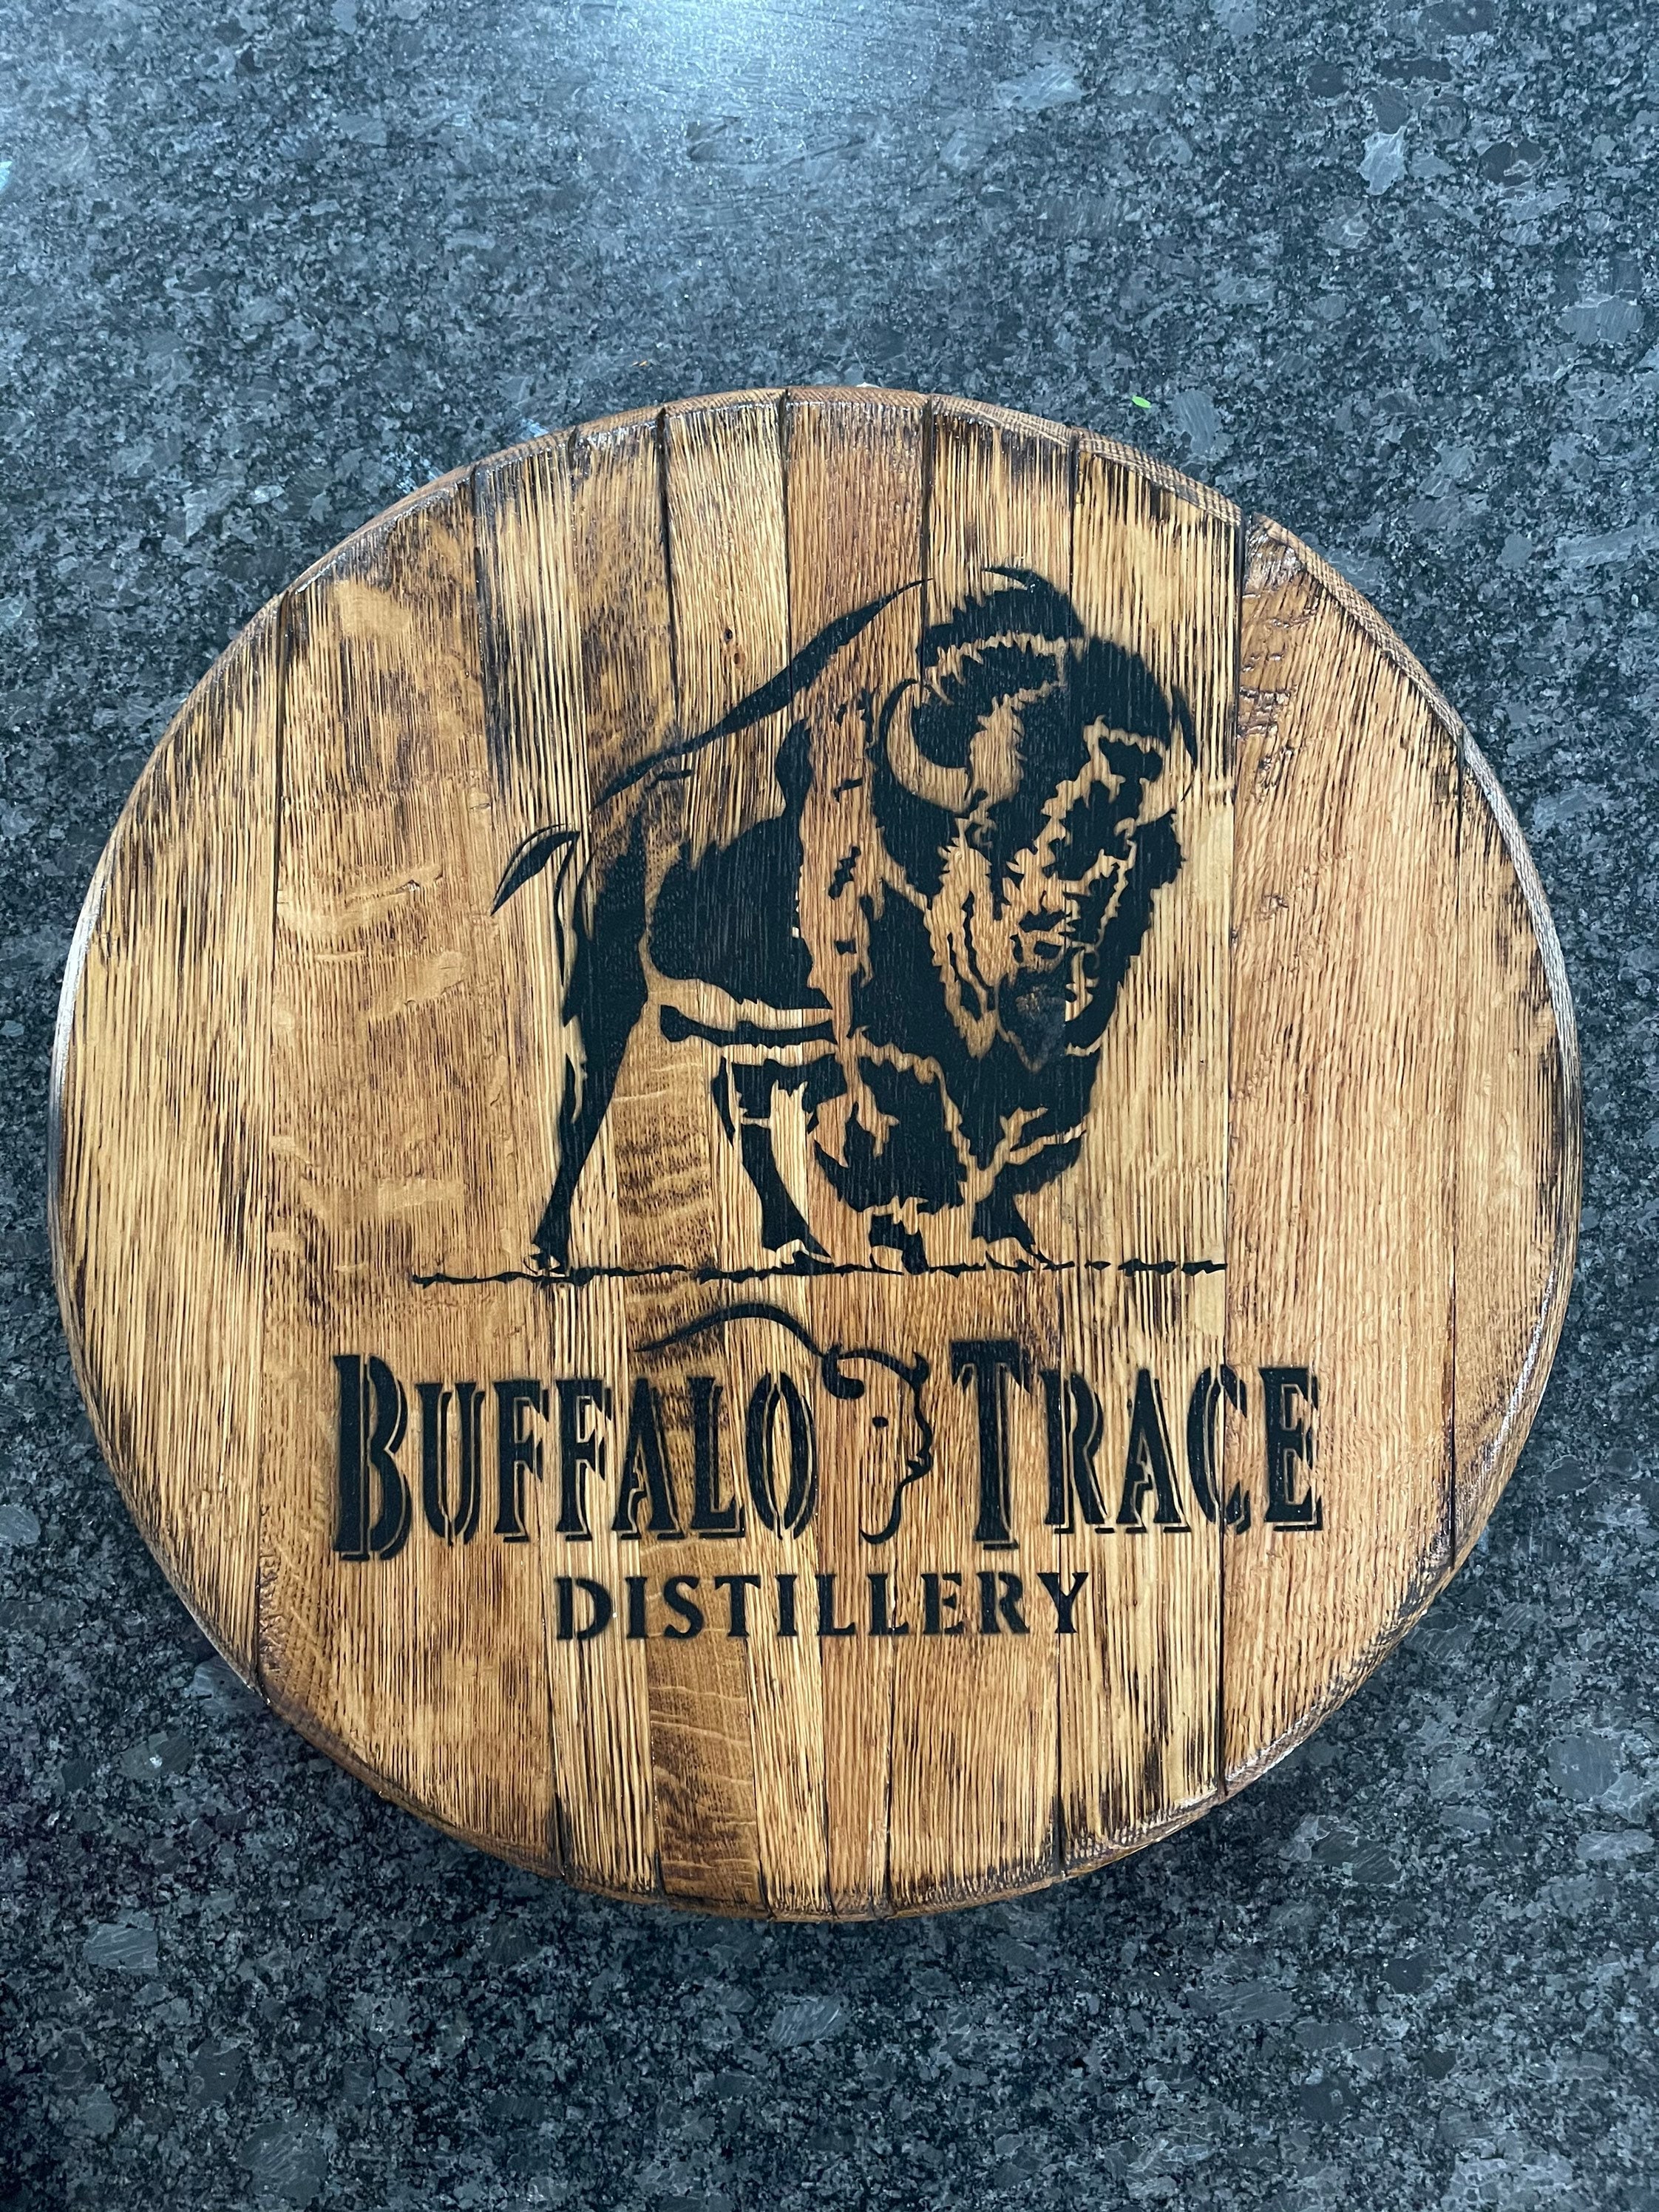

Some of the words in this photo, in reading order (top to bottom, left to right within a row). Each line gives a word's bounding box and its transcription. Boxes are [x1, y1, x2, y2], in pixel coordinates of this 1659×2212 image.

[333, 1354, 815, 1561] BUFFALO
[951, 1340, 1323, 1550] TRACE
[555, 1571, 1089, 1641] DISTILLERY
